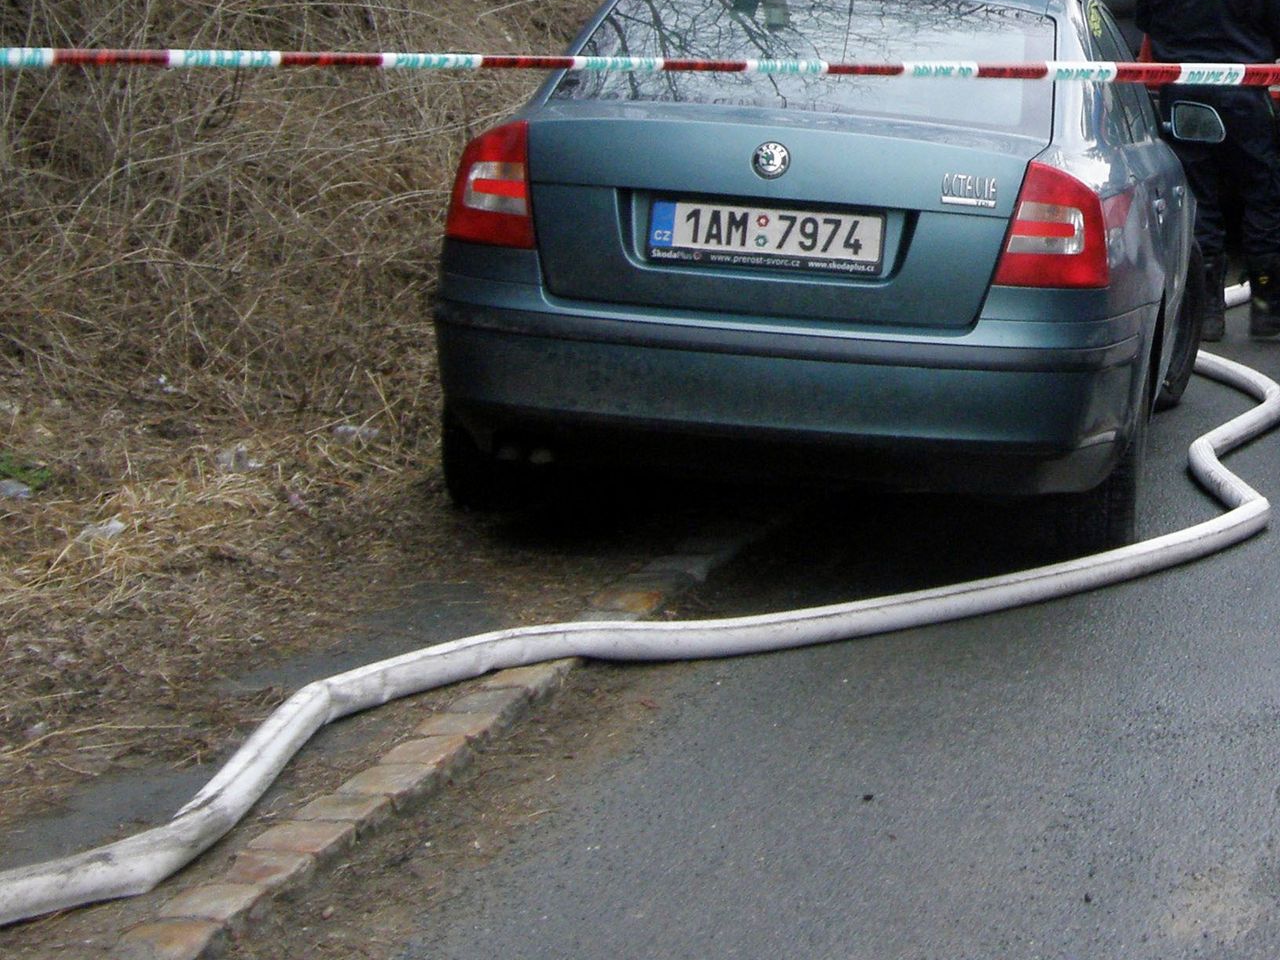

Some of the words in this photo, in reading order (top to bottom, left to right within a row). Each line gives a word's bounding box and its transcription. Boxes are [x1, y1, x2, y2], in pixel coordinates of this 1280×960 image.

[941, 172, 997, 200] OCTAVIA
[654, 229, 672, 241] CZ
[685, 208, 749, 247] 1AM
[775, 214, 863, 256] 7974
[710, 253, 801, 268] www.prerost-svorc.cz
[807, 260, 875, 273] www.skodaplus.cz
